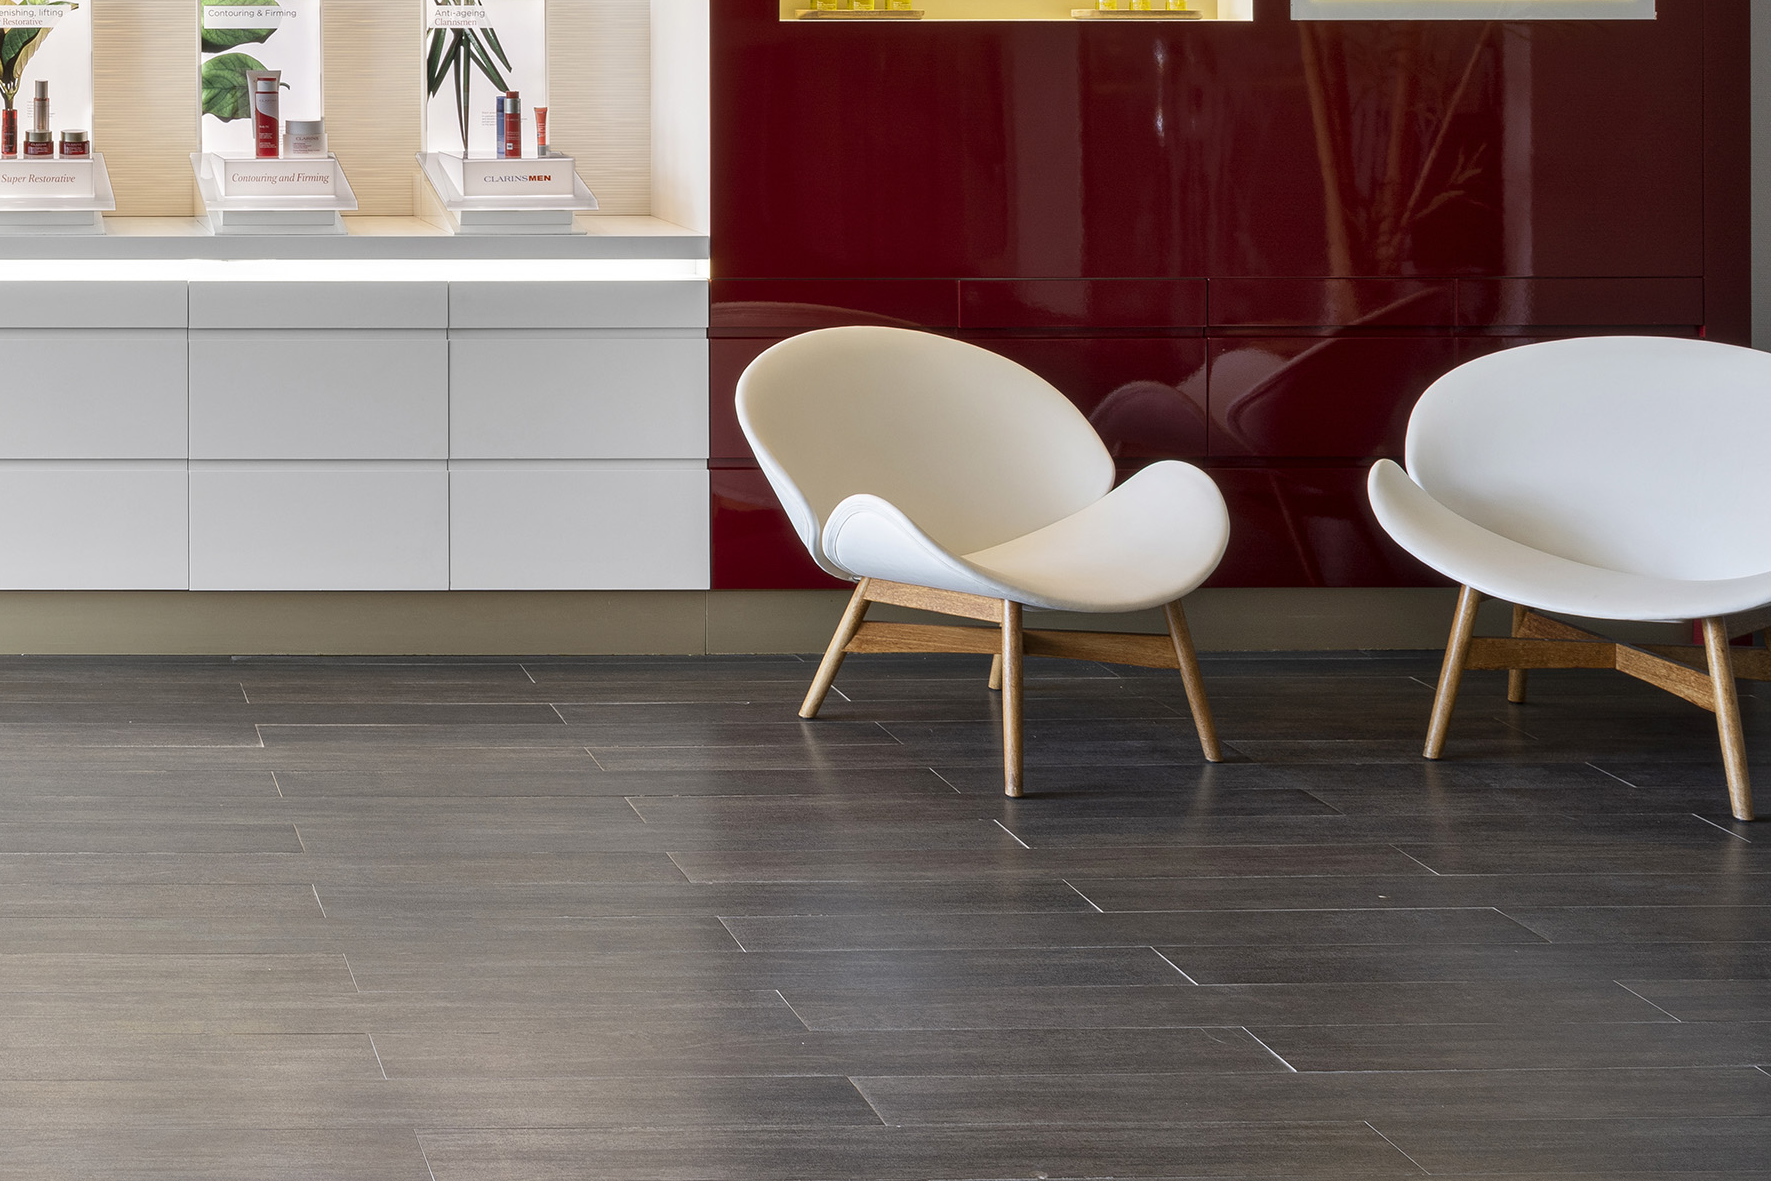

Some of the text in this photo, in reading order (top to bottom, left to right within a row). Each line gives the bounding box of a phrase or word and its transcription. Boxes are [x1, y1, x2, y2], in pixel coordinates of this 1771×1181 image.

[38, 8, 64, 18] lifting
[208, 9, 297, 18] Contouring & Firming
[434, 9, 486, 19] Anti-ageing
[2, 18, 43, 27] Restorative
[1, 173, 76, 186] Super Restorative
[231, 172, 330, 185] Contouring and Firming
[483, 175, 552, 183] CLARINSMEN
